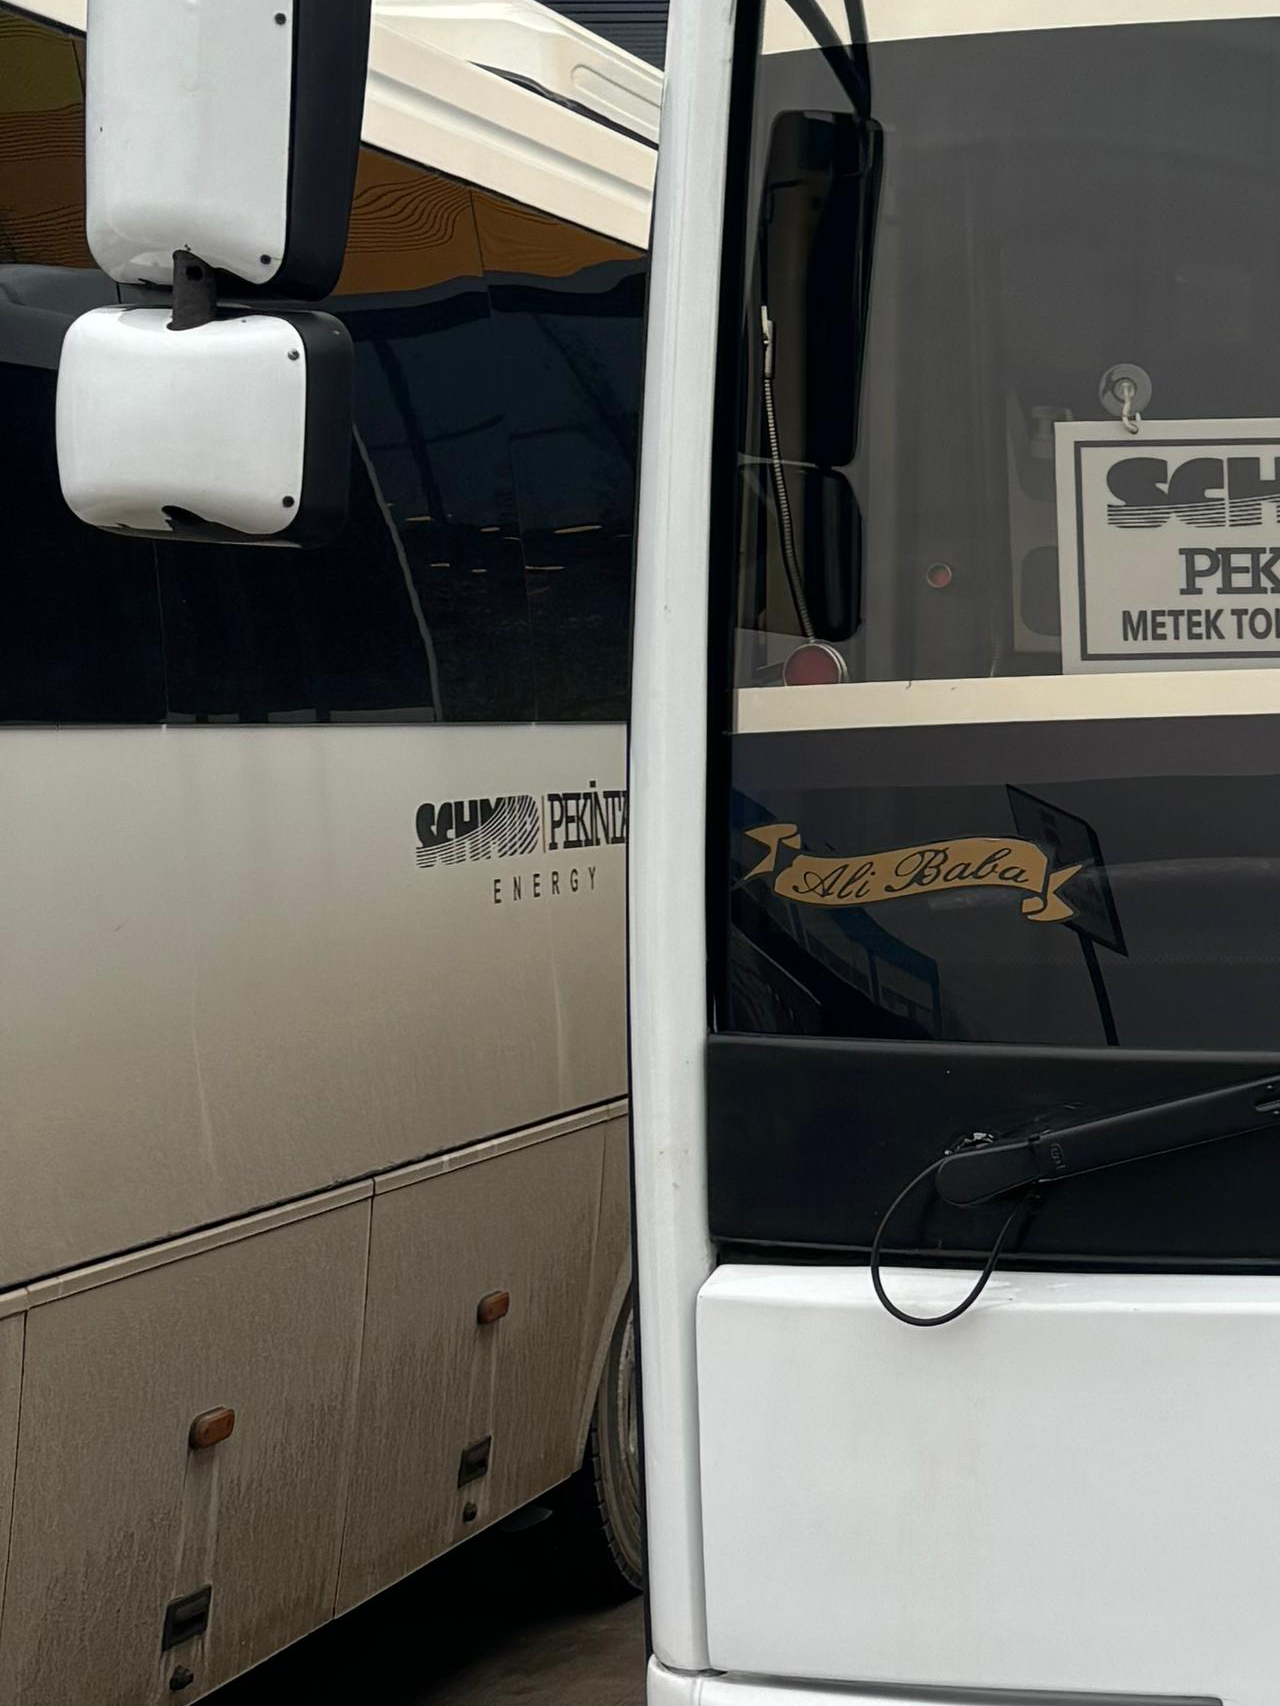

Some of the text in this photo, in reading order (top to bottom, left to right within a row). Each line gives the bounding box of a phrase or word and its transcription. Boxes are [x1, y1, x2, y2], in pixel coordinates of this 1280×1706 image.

[1121, 609, 1225, 642] METEK
[416, 794, 540, 869] SCHMID
[494, 866, 597, 904] ENERGY
[792, 847, 1028, 899] Ali Baba
